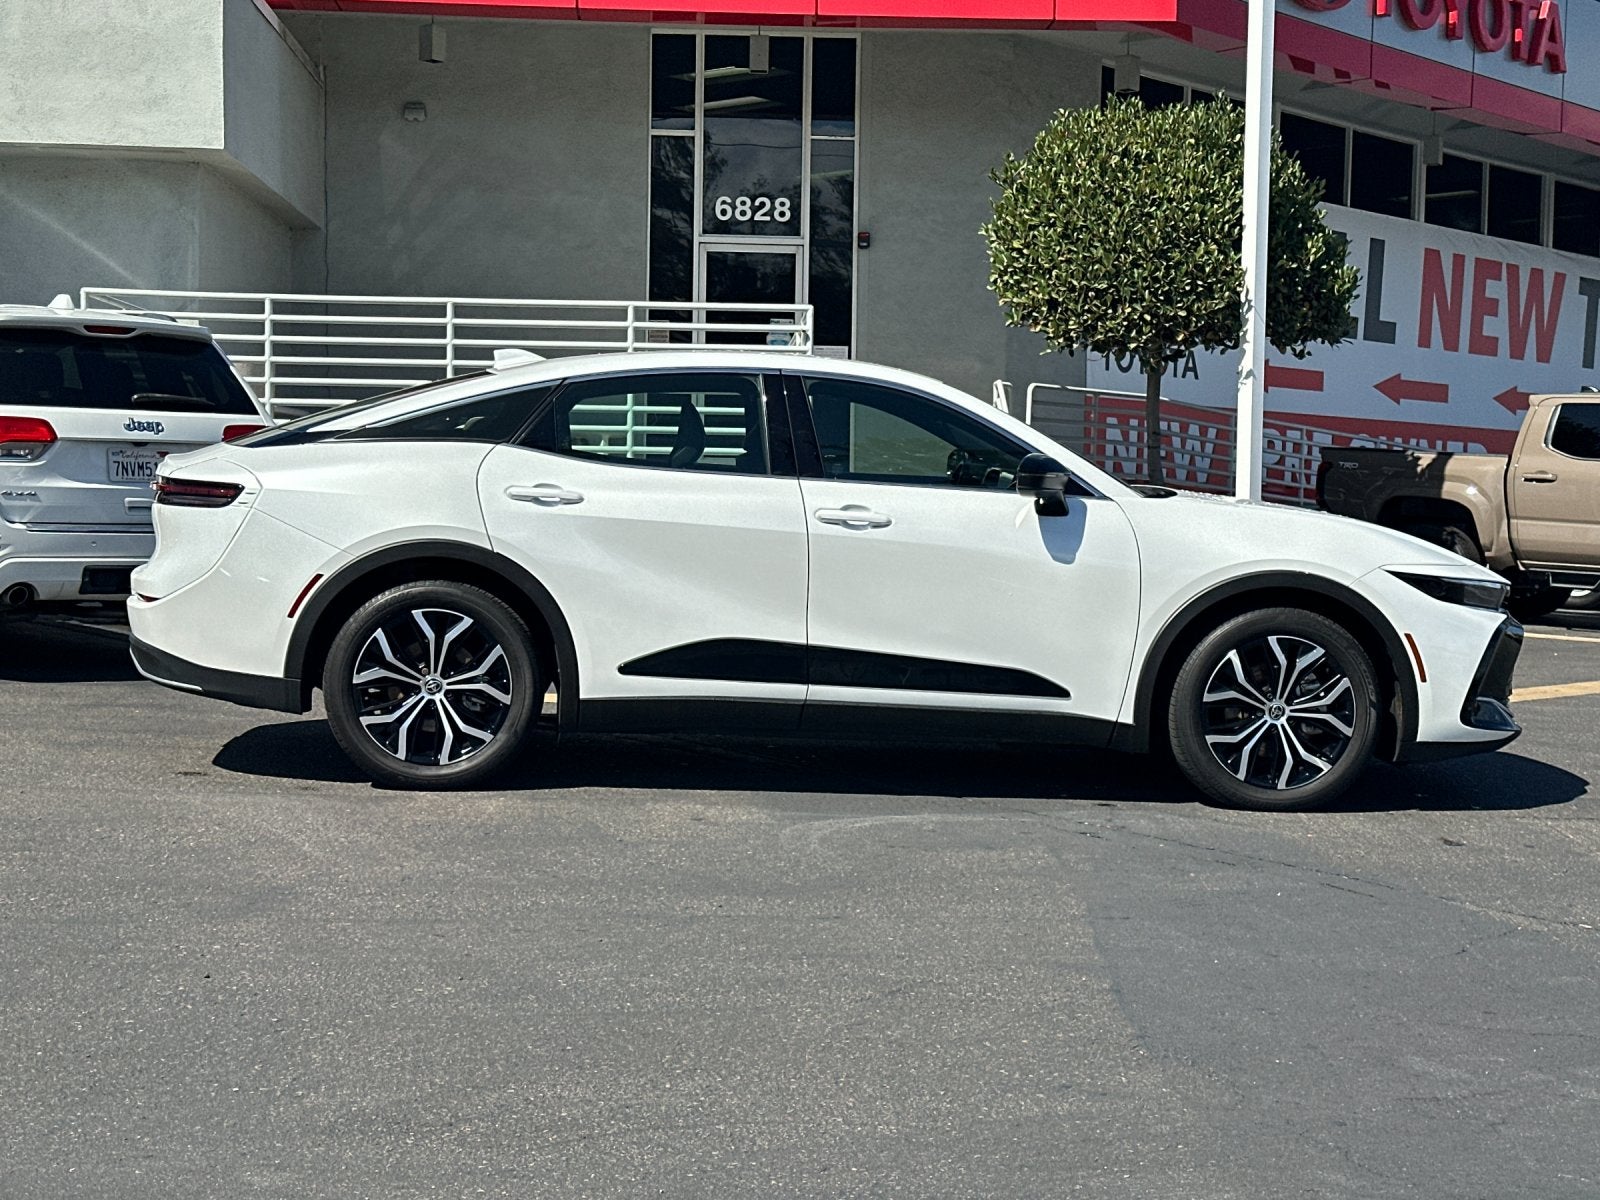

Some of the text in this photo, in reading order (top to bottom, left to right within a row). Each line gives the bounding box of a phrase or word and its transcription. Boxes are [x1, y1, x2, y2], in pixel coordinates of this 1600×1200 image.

[1373, 0, 1567, 74] OYOTA
[715, 195, 791, 223] 6828
[1417, 247, 1567, 364] NEW
[123, 416, 165, 435] Jeep
